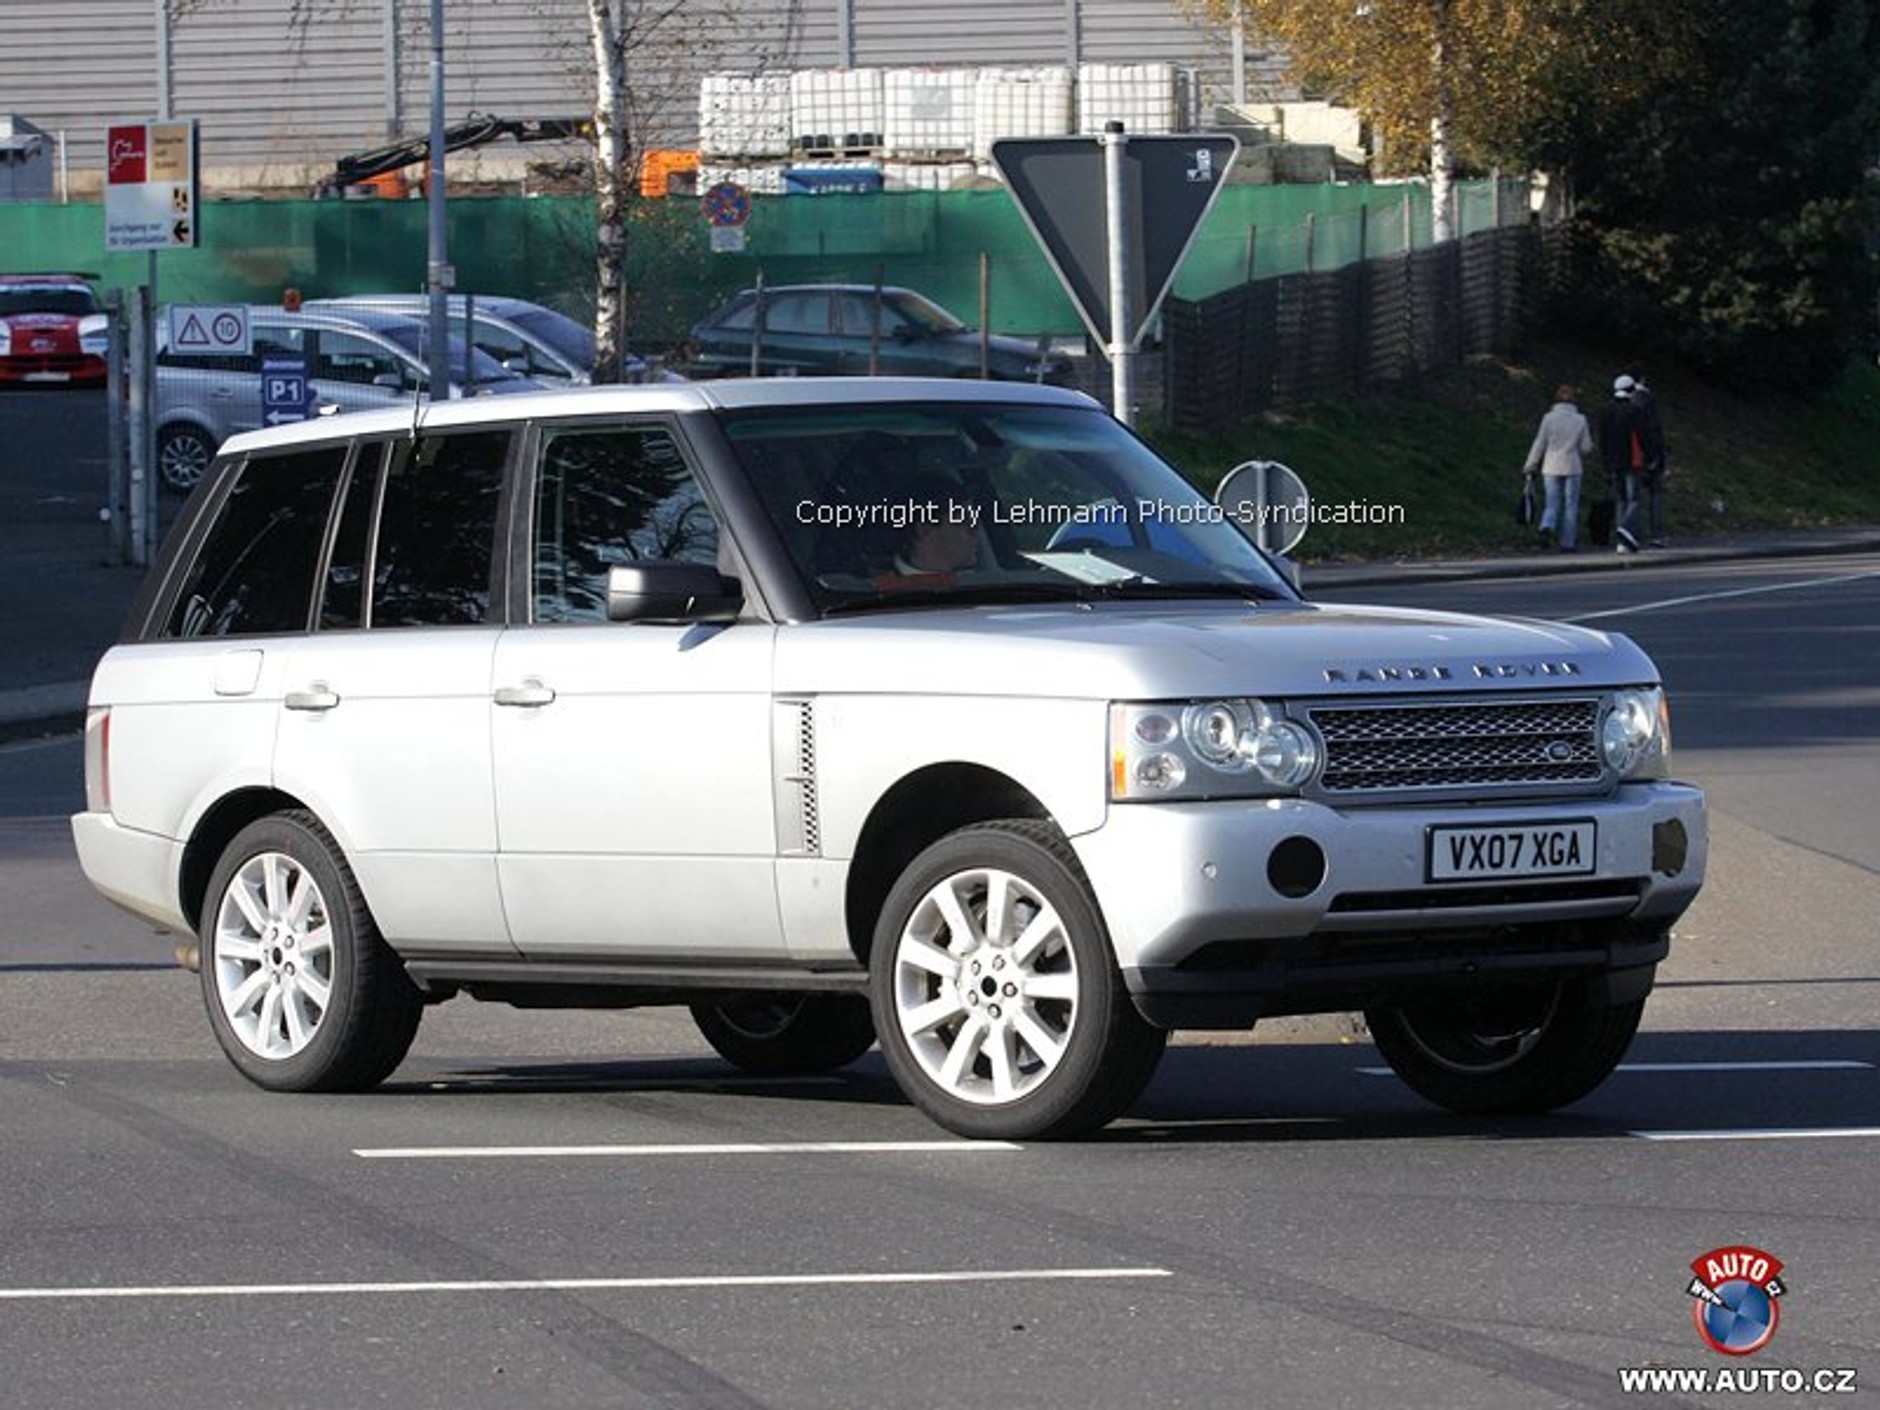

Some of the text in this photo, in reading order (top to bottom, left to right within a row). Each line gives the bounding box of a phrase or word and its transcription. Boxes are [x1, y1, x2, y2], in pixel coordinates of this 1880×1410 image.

[220, 321, 235, 337] 10
[271, 380, 298, 400] P1
[1322, 661, 1581, 683] RANGE ROVER
[1450, 830, 1581, 871] VX07 XGA
